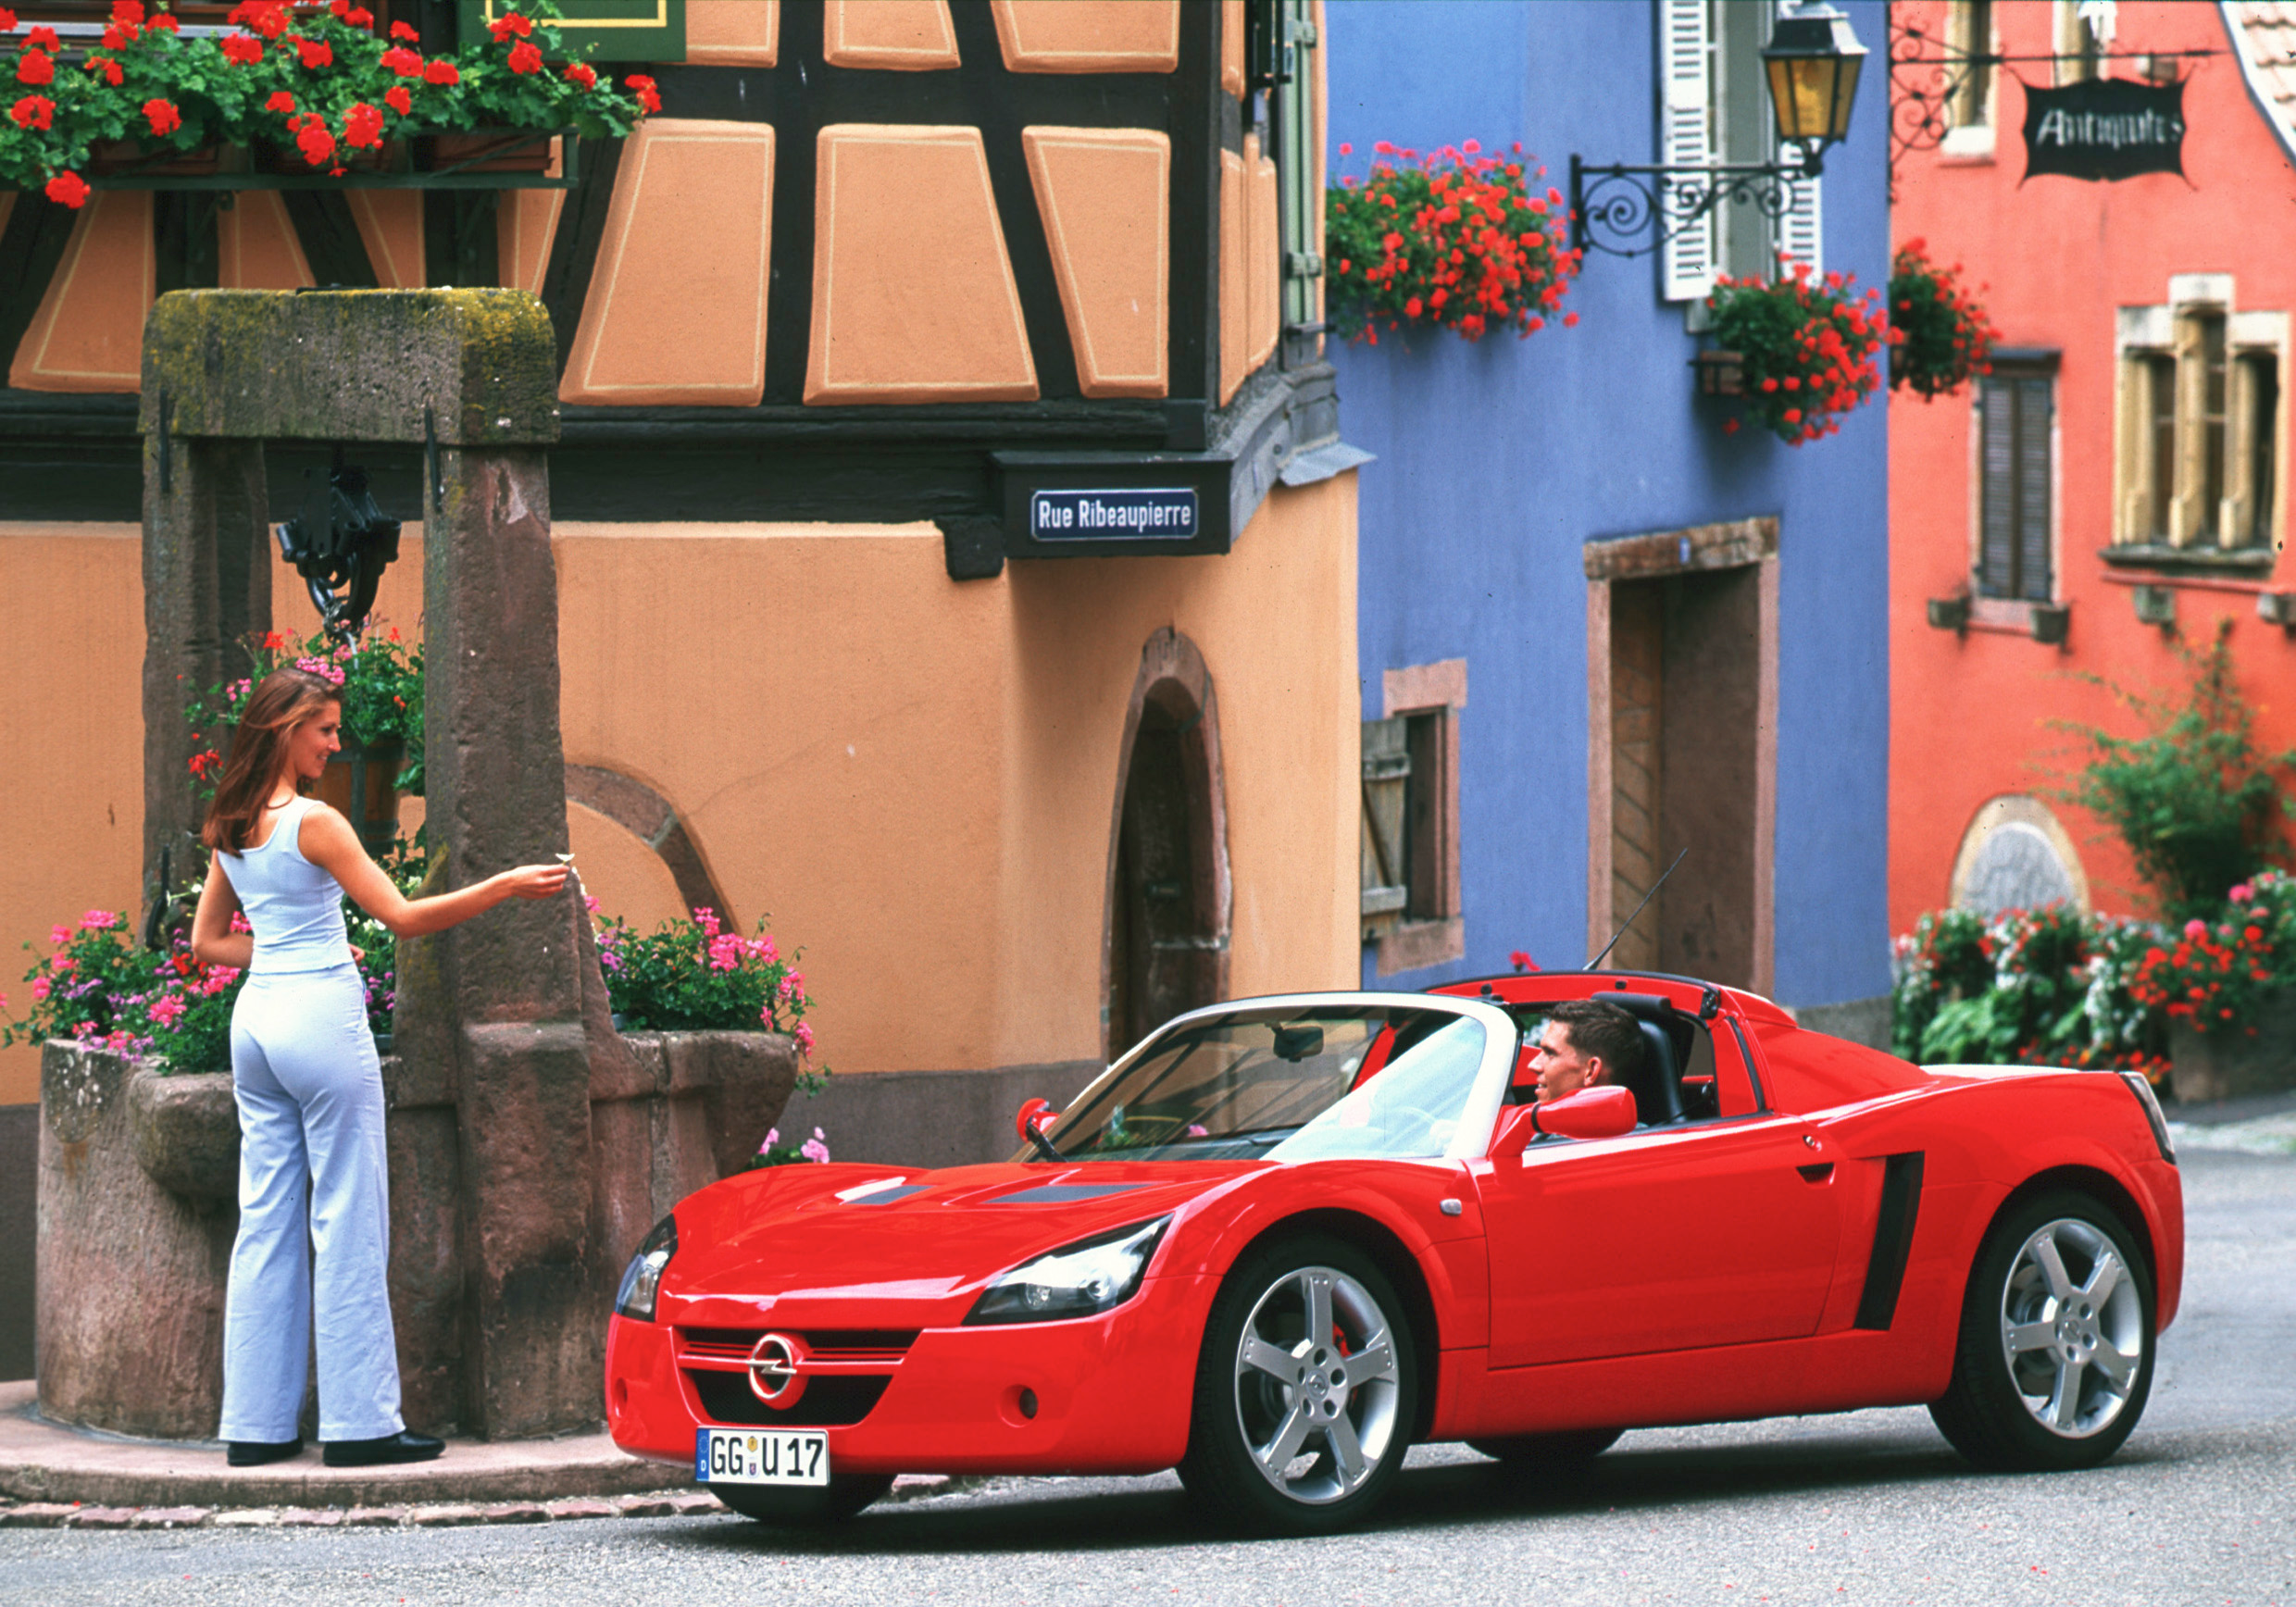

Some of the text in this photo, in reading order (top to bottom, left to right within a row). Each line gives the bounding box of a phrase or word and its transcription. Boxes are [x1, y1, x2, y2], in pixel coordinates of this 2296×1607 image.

[1039, 500, 1192, 533] Rue Ribeaupierre
[700, 1460, 707, 1472] D
[711, 1436, 823, 1477] GG U 17
